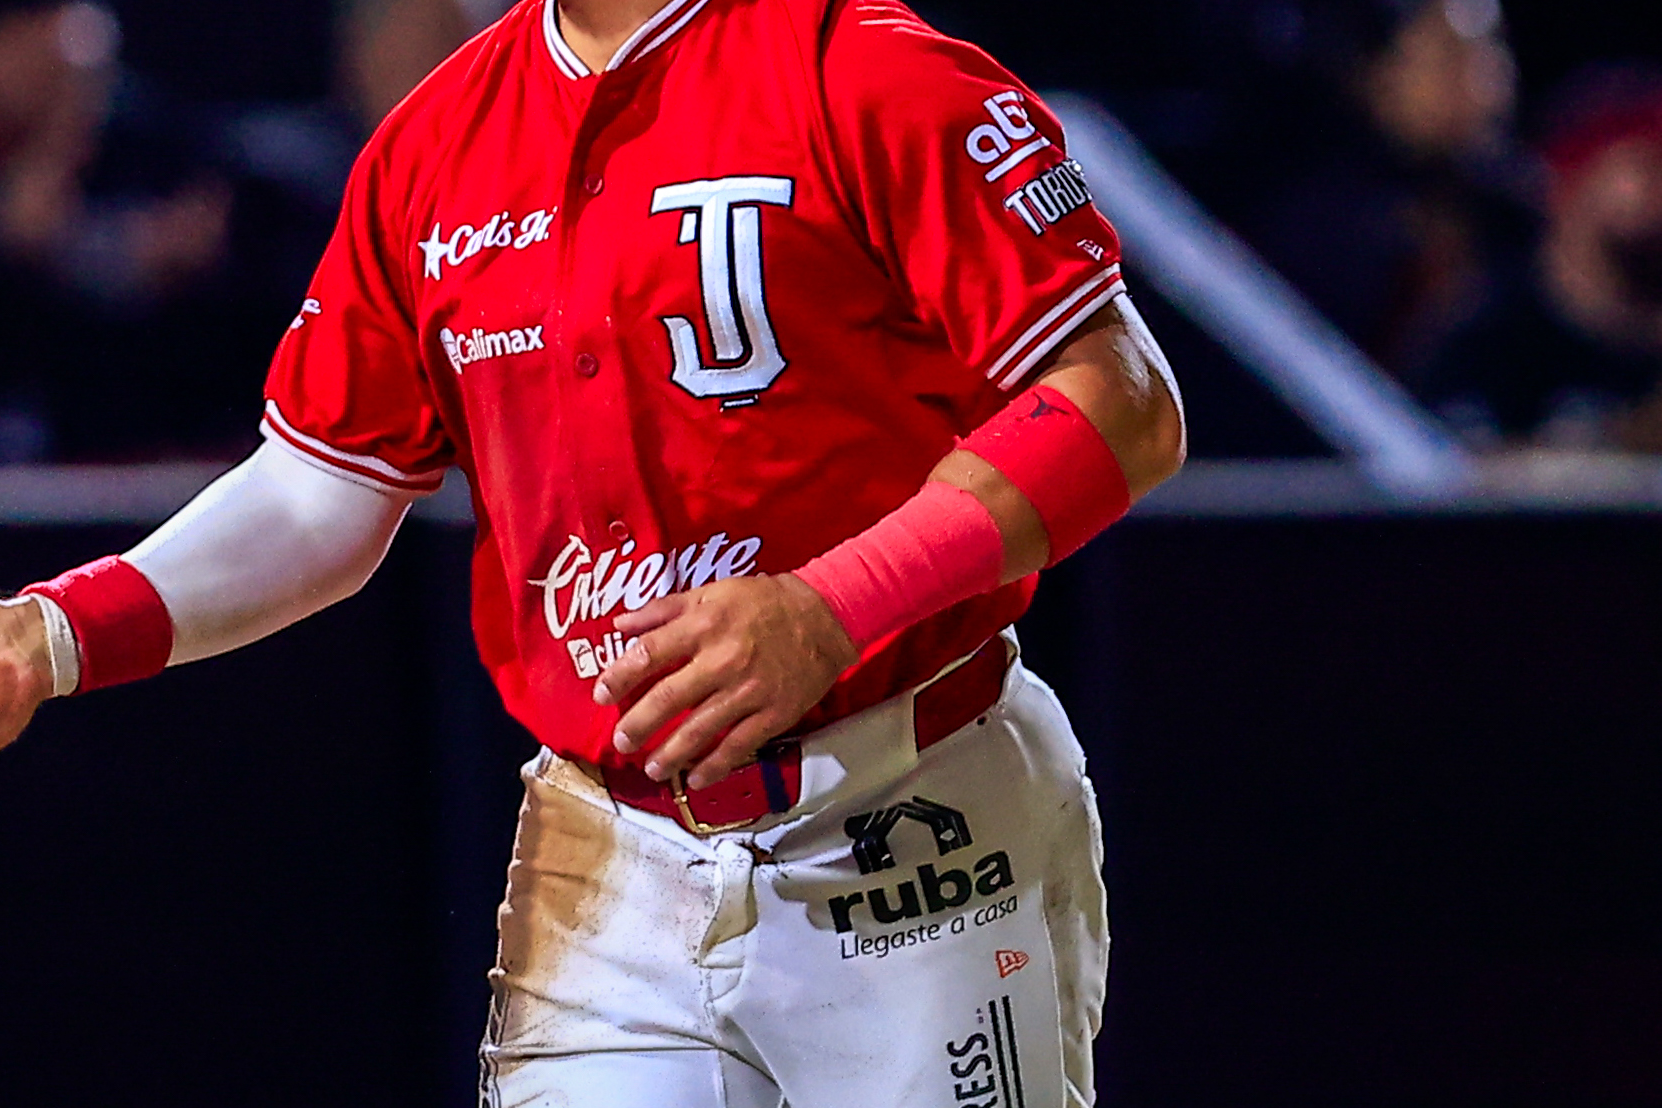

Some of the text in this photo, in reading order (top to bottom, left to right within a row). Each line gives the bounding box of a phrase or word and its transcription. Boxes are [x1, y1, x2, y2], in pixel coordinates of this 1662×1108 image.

[456, 325, 545, 364] Calimax
[828, 850, 1015, 934] ruba
[841, 895, 1018, 960] Llegaste a casa
